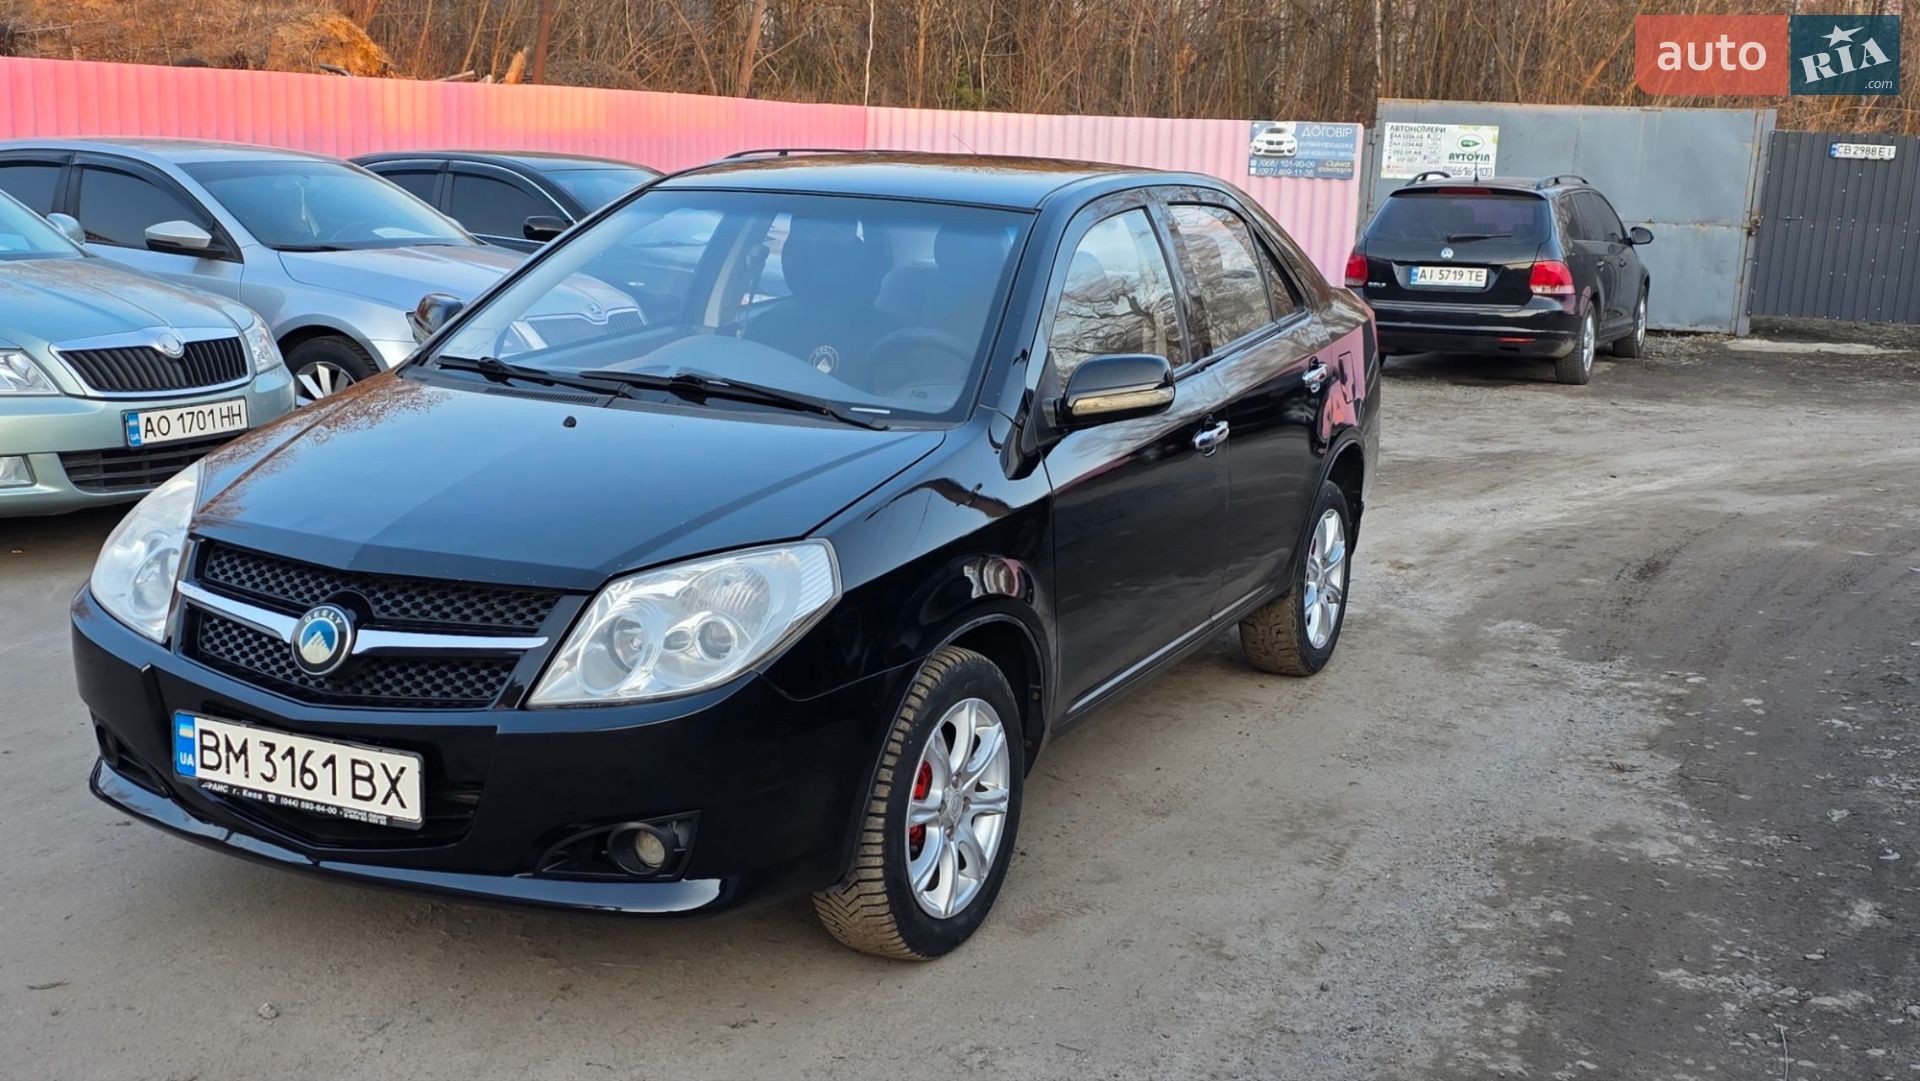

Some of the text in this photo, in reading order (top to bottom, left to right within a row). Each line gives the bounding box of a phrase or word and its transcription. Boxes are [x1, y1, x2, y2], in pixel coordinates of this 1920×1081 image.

[1301, 125, 1353, 138] ДОГОВІР
[1389, 125, 1447, 133] АВТОНОМЕРИ
[1419, 269, 1433, 280] AI
[1438, 269, 1464, 281] 5719
[1467, 270, 1484, 282] TE
[144, 404, 242, 439] AO 1701 HH
[304, 609, 343, 625] GEELY
[180, 751, 195, 767] UA
[199, 728, 407, 809] BM 3161 BX
